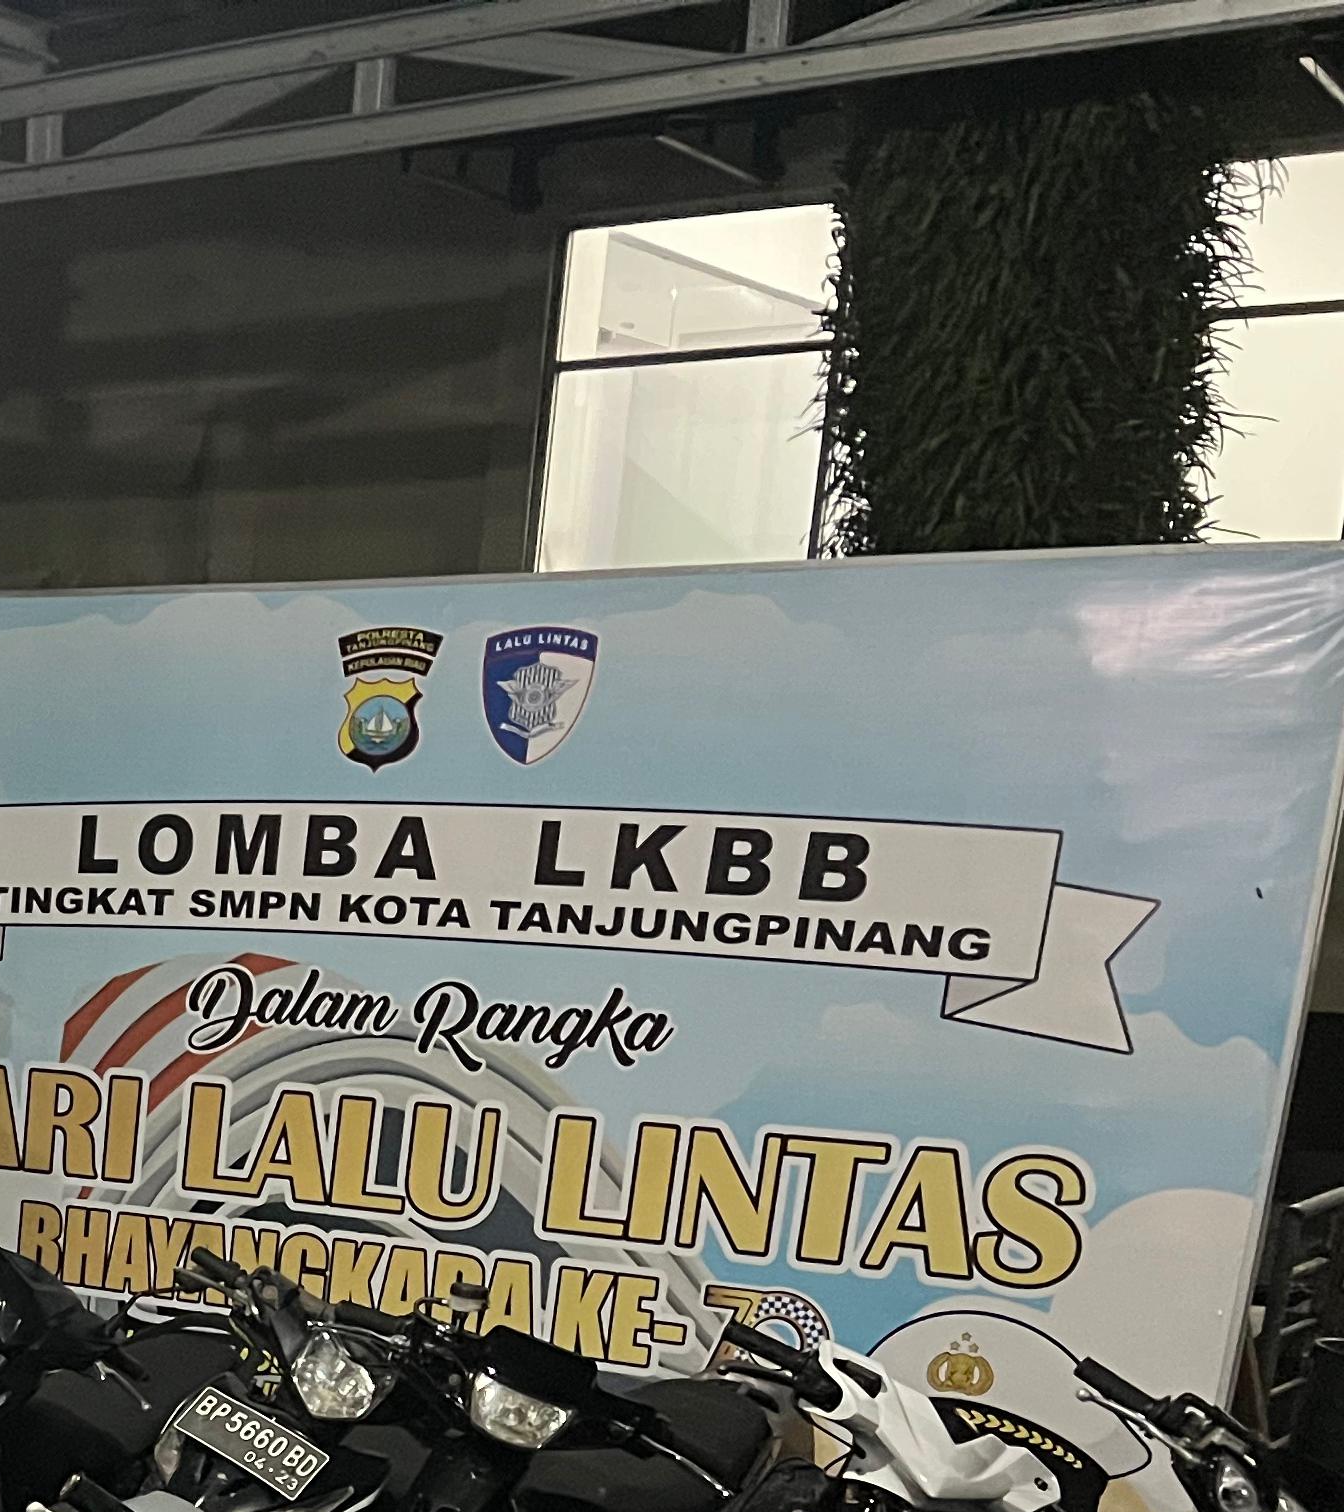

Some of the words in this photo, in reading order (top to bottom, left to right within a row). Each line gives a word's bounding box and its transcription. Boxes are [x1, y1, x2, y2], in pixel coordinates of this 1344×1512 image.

[495, 634, 532, 651] LALU
[538, 633, 588, 650] LINTAS
[78, 813, 437, 881] LOMBA
[534, 820, 871, 902] LKBB
[189, 889, 321, 922] SMPN
[339, 894, 471, 929] KOTA
[490, 900, 992, 961] TANJUNGPINANG
[188, 967, 400, 1051] Dalam
[414, 981, 674, 1072] Rangka
[182, 1082, 502, 1223] LALU
[541, 1113, 1087, 1289] LINTAS
